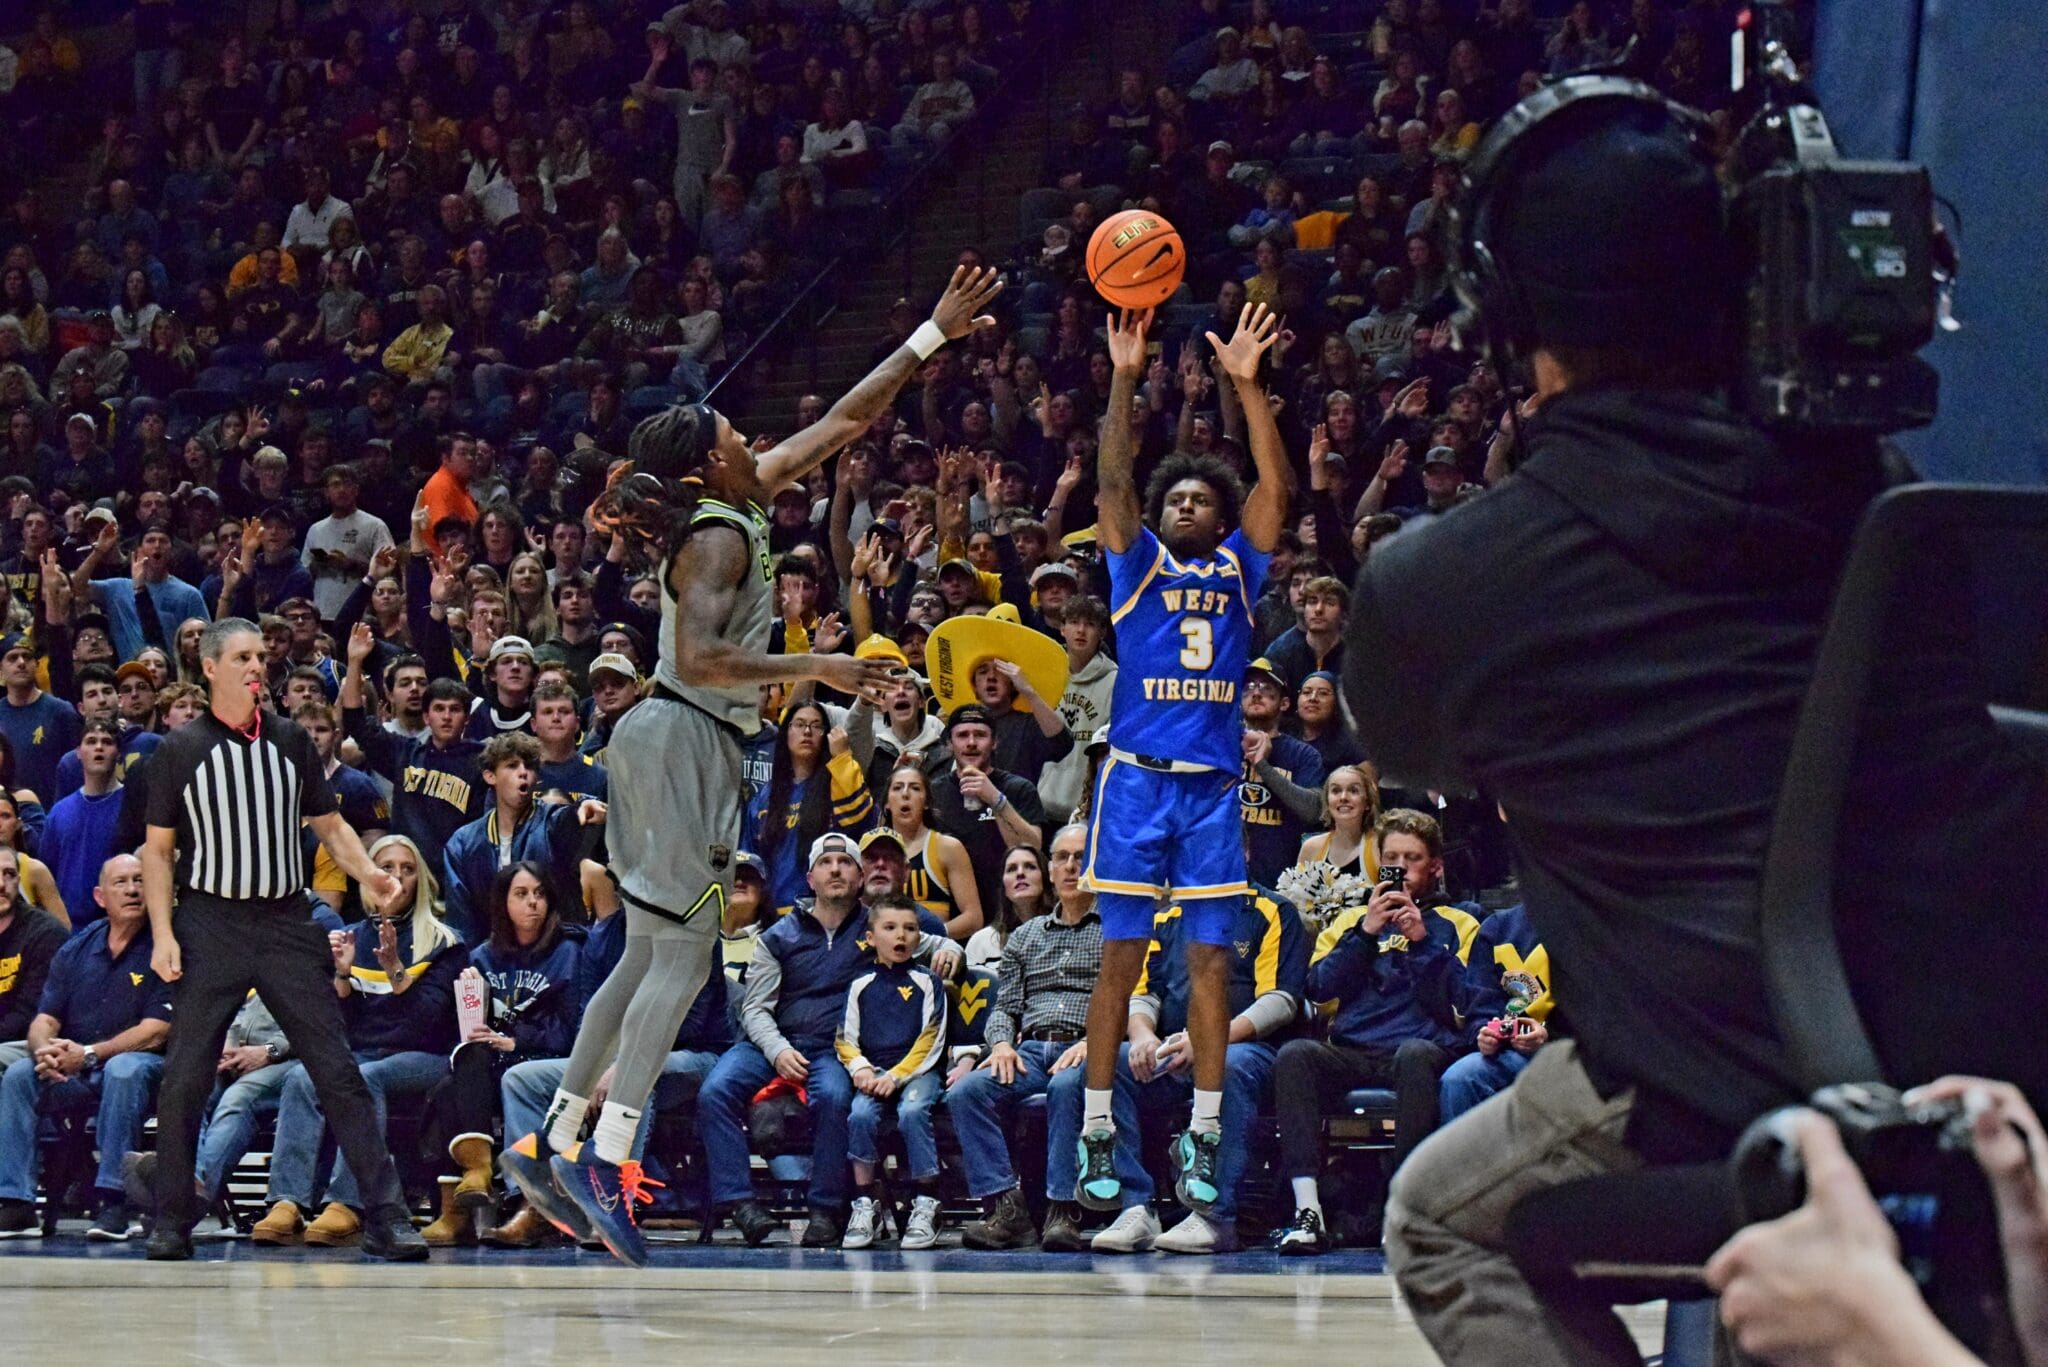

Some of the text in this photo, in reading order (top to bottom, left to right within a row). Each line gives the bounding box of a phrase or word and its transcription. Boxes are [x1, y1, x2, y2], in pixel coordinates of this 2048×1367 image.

[1112, 218, 1160, 249] ELITE
[1161, 589, 1230, 615] WEST
[1179, 616, 1214, 671] 3
[938, 636, 954, 700] WEST VIRGINIA
[1142, 678, 1235, 704] VIRGINIA
[1240, 804, 1283, 826] TBALL
[486, 970, 508, 990] EST
